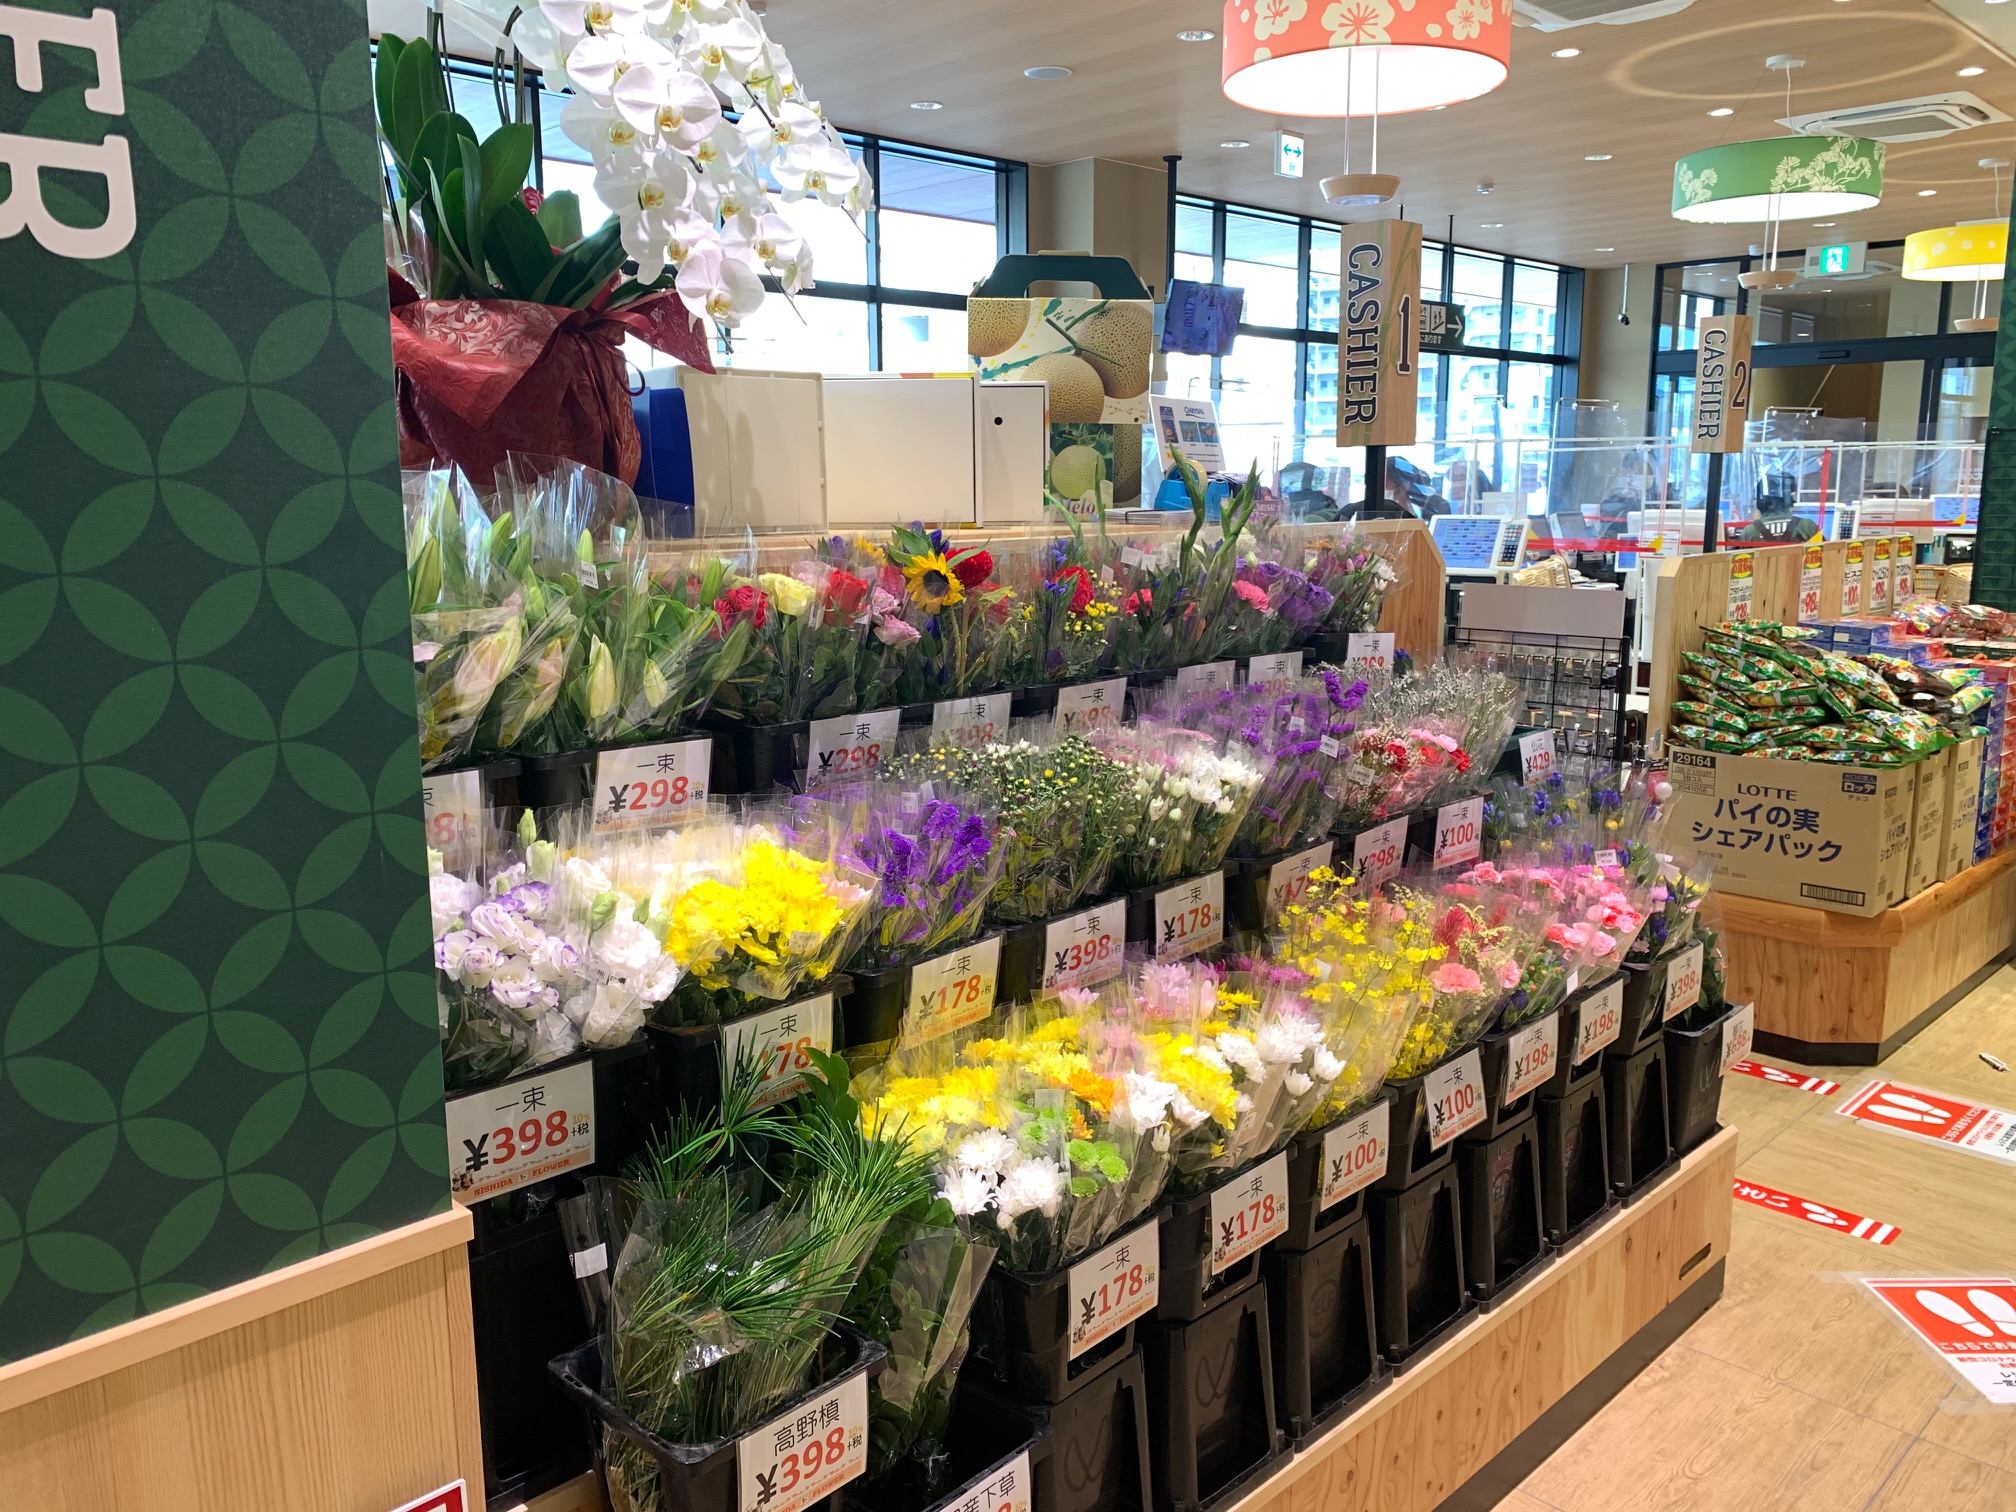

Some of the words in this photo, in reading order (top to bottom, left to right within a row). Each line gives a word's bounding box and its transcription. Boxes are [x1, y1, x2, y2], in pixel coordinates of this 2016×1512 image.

[1345, 243, 1381, 425] CASHIER
[1399, 295, 1410, 374] 1
[1698, 330, 1726, 439] CASHIER
[1732, 361, 1747, 408] 2
[1364, 640, 1380, 653] 一束
[1267, 660, 1285, 674] 一束
[1081, 688, 1104, 703] 一束
[840, 723, 871, 741] 一束
[637, 753, 675, 773] 一束
[819, 743, 880, 776] ¥298
[1525, 751, 1550, 774] ¥429
[1676, 753, 1712, 767] 29164
[609, 776, 688, 812] ¥298
[1737, 783, 1797, 801] LOTTE
[1843, 782, 1876, 793] ロッテ
[1452, 806, 1469, 821] 一束
[1714, 798, 1819, 834] パイの実
[1372, 830, 1390, 845] 一束
[1440, 822, 1473, 850] ¥100
[1692, 820, 1843, 863] シェアパック
[1290, 857, 1311, 872] 一束
[1178, 886, 1202, 904] 一束
[1074, 916, 1100, 935] 一束
[1164, 903, 1211, 943] ¥178
[941, 955, 971, 976] 一束
[1055, 934, 1110, 974] ¥398
[919, 974, 981, 1020] ¥178
[1671, 970, 1696, 1001] ¥398
[760, 1014, 798, 1037] 一束
[1526, 1027, 1543, 1044] 一束
[1584, 1009, 1614, 1044] ¥198
[1514, 1042, 1549, 1081] ¥198
[1444, 1066, 1464, 1085] 一束
[495, 1086, 546, 1113] 一束
[1433, 1083, 1474, 1126] ¥100
[463, 1110, 569, 1172] ¥398
[571, 1123, 589, 1137] +税
[1347, 1120, 1369, 1140] 一束
[1332, 1137, 1377, 1183] ¥100
[474, 1178, 513, 1196] NISHIDA
[532, 1158, 570, 1177] FLOWER
[1237, 1175, 1264, 1199] 一束
[1221, 1193, 1275, 1247] ¥178
[1100, 1245, 1130, 1271] 一束
[1080, 1264, 1143, 1325] ¥178
[773, 1398, 840, 1457] 高野槙
[847, 1434, 863, 1451] +税
[755, 1426, 845, 1506] ¥398
[812, 1473, 845, 1497] FLOWER
